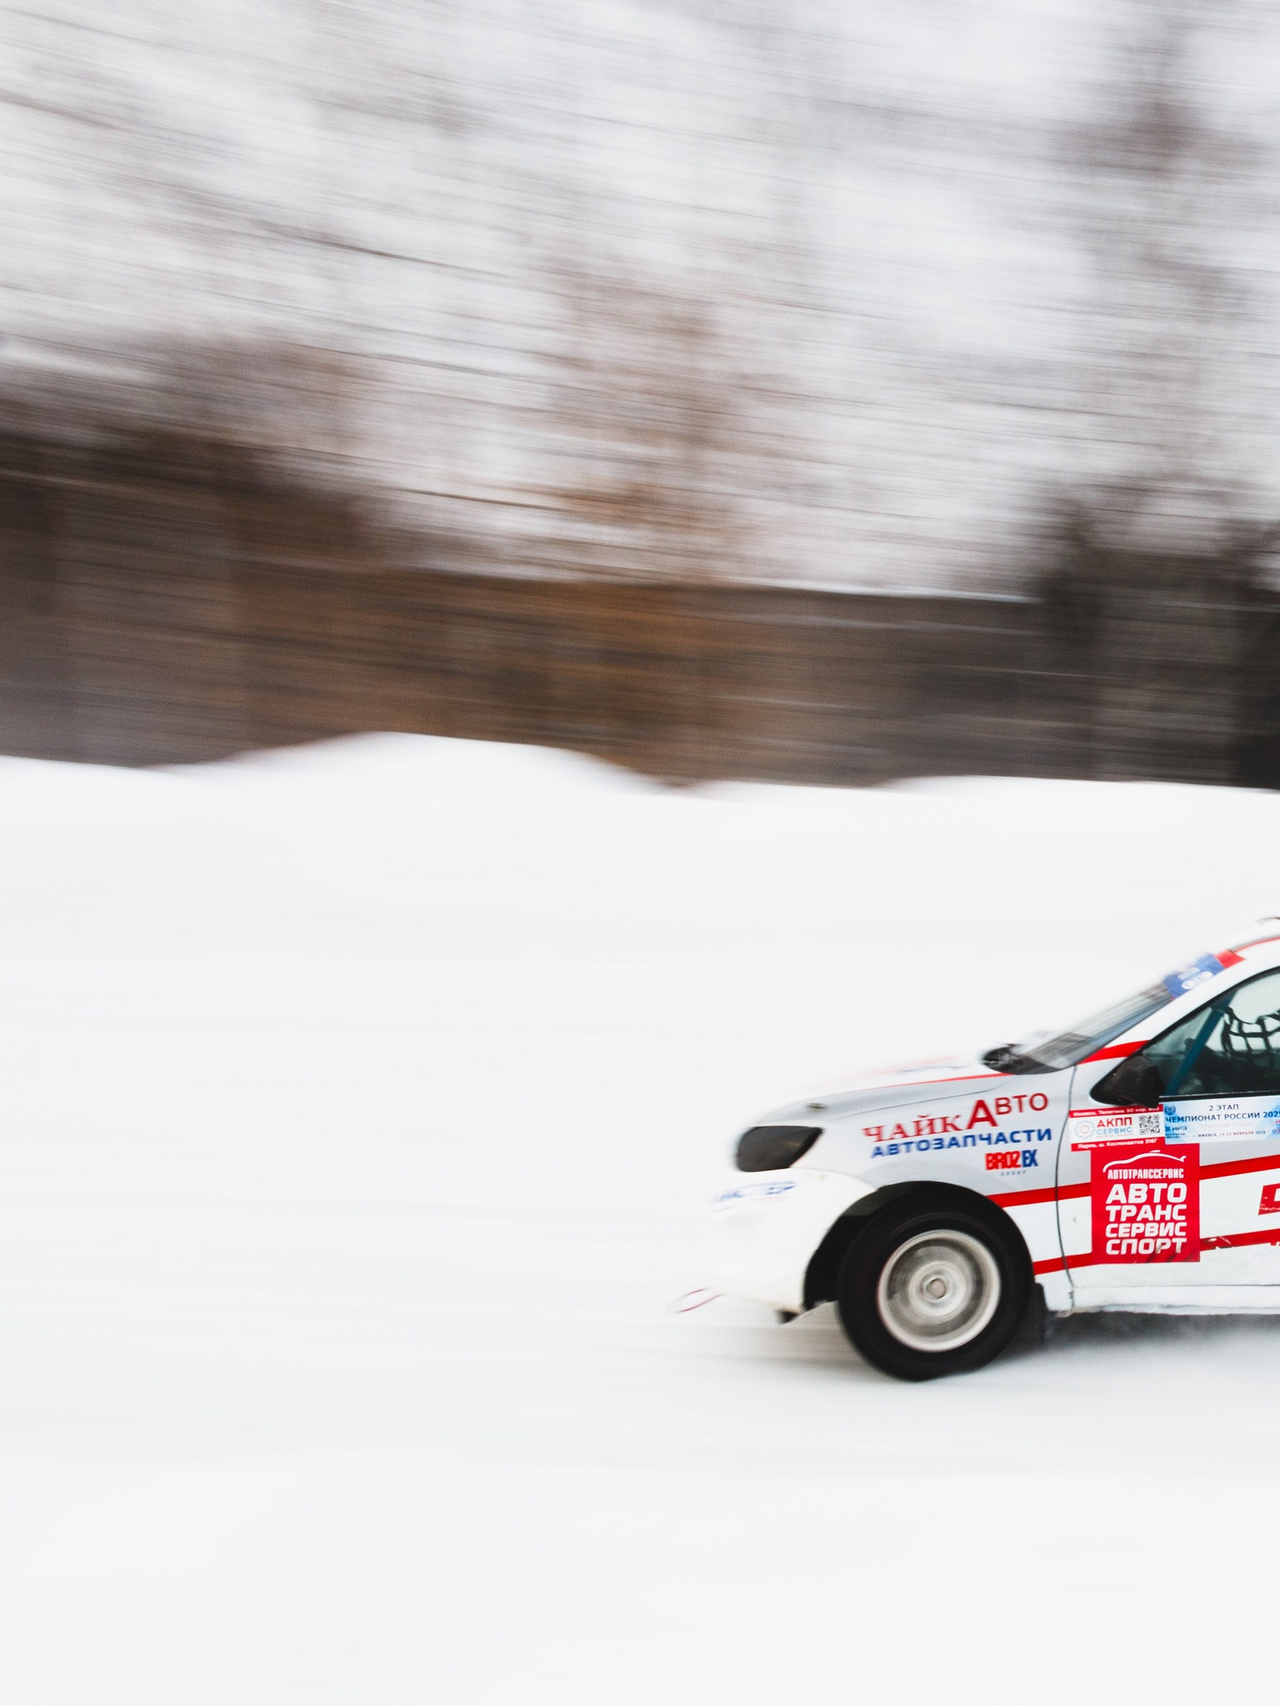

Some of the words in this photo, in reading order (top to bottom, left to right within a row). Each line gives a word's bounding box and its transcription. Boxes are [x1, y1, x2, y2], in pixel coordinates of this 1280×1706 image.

[1216, 1103, 1239, 1111] ЭТАП
[1097, 1116, 1133, 1128] АКПП
[1165, 1114, 1221, 1123] ЧЕМПИОНАТ
[1224, 1112, 1260, 1120] РОССИИ
[1096, 1126, 1133, 1136] СЕРВИС
[871, 1127, 1052, 1158] АВТОЗАПЧАСТИ
[1107, 1168, 1184, 1180] АВТОТРАНССЕРВИС
[1105, 1182, 1187, 1204] АВТО
[1105, 1204, 1187, 1222] ТРАНС
[1105, 1222, 1187, 1238] СЕРВИС
[1105, 1238, 1187, 1255] СПОРТ
